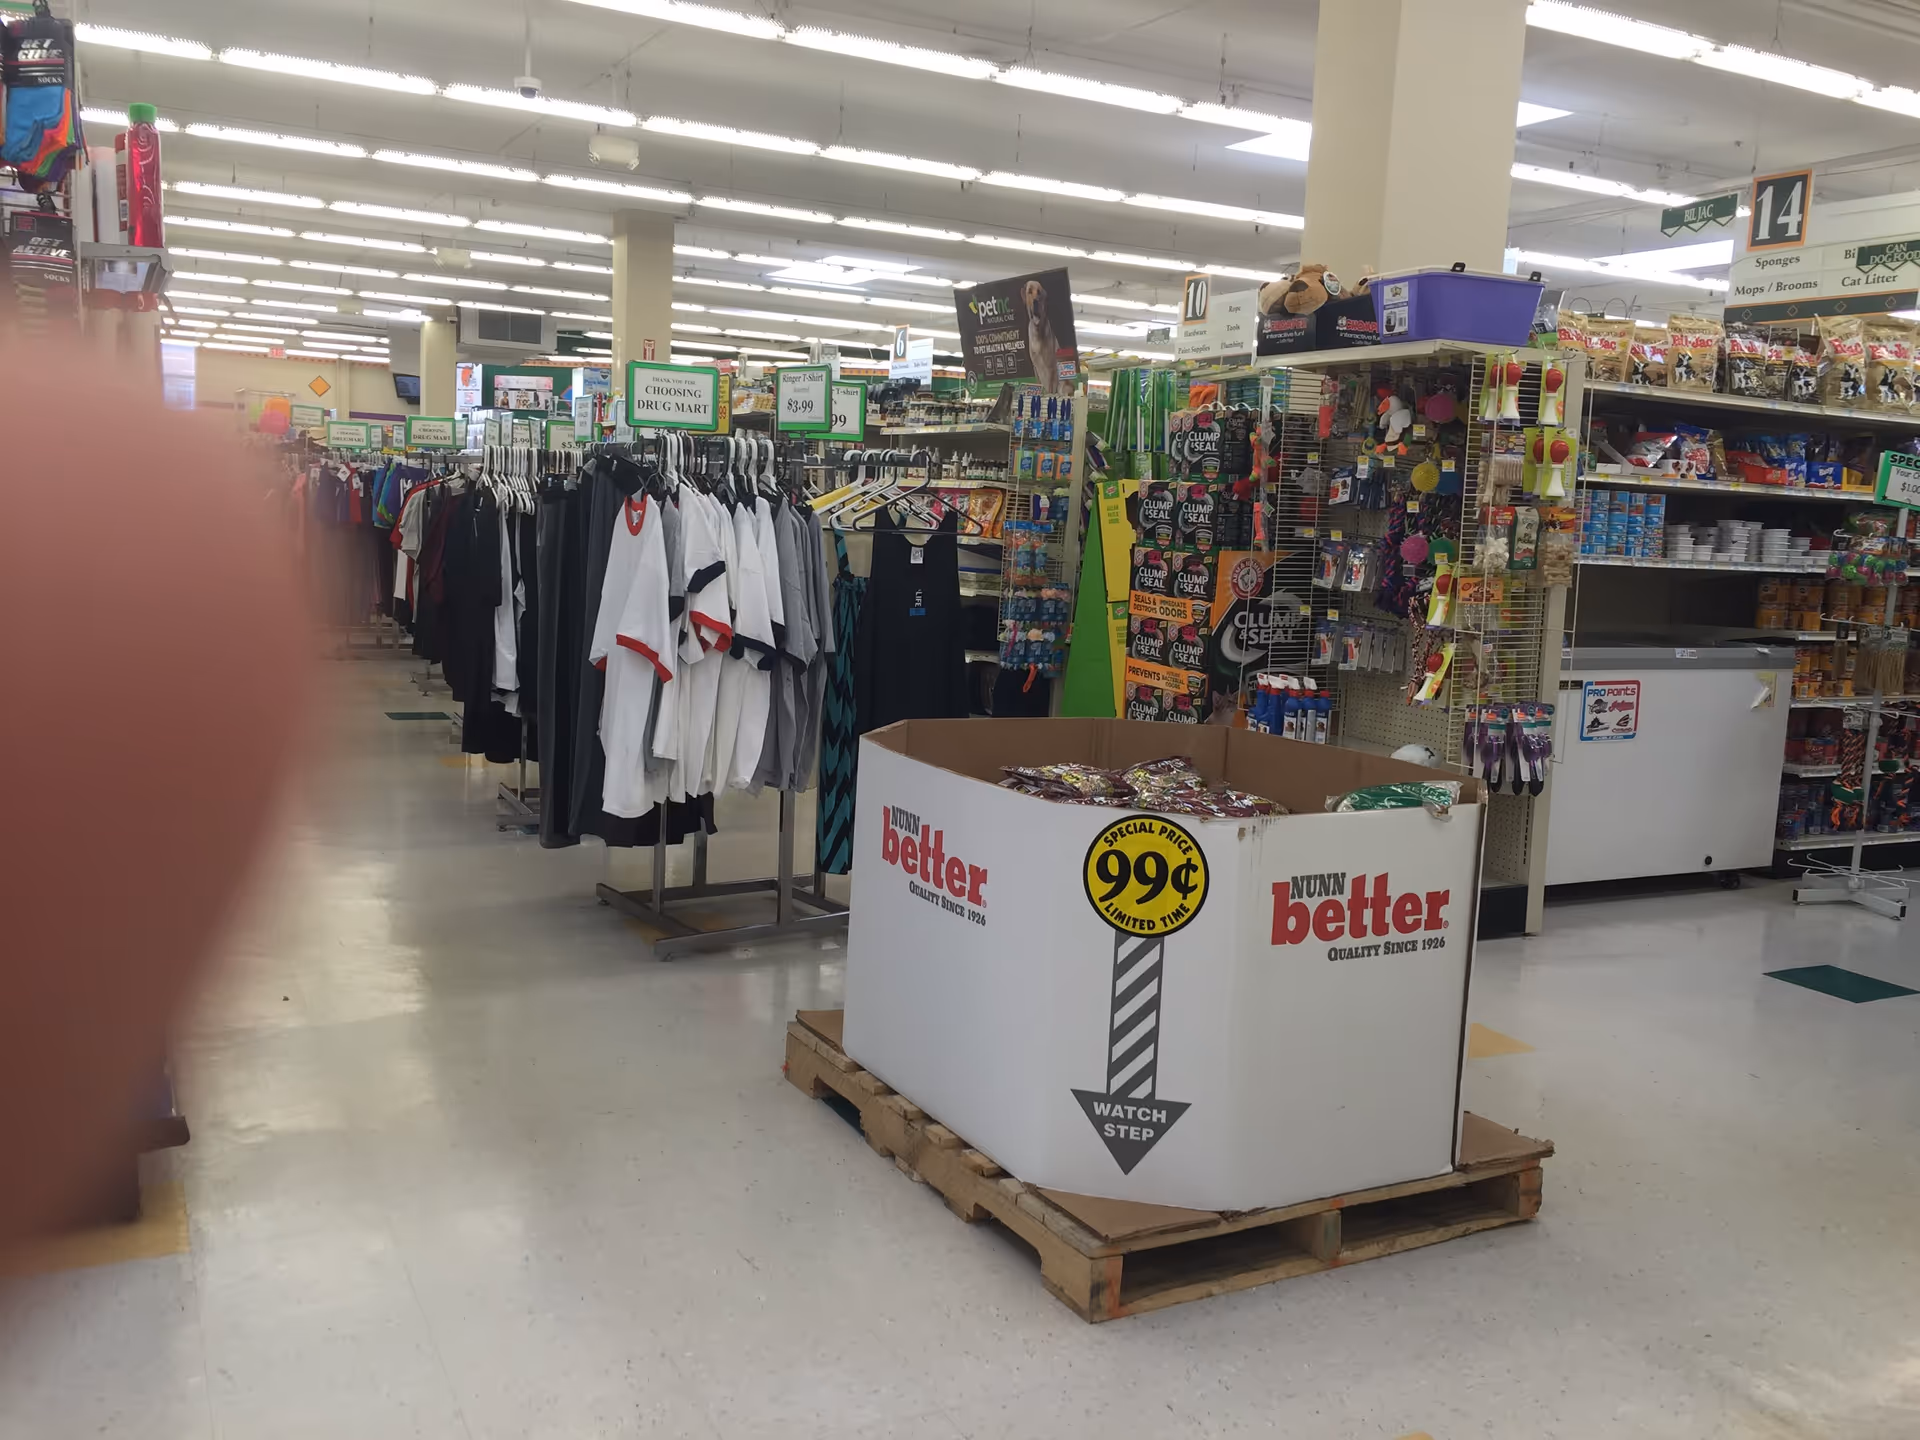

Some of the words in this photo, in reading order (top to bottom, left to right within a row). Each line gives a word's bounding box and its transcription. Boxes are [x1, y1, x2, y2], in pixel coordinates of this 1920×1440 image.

[1684, 208, 1697, 222] BIL
[1697, 204, 1714, 222] JAC
[1755, 180, 1803, 241] 14
[29, 237, 63, 247] GET
[1886, 243, 1908, 254] CAN
[13, 245, 71, 257] ACTIVE
[1755, 255, 1801, 270] Sponges
[1870, 253, 1892, 265] DOG
[44, 273, 70, 282] SOCKS
[1841, 276, 1862, 287] Cat
[1865, 272, 1899, 285] Litter
[1734, 284, 1765, 297] Mops
[1775, 279, 1818, 292] Brooms
[1186, 281, 1207, 318] 10
[896, 330, 905, 357] 6
[782, 374, 801, 384] Ringer
[803, 373, 824, 382] T-Shirt
[645, 385, 702, 399] CHOOSING
[637, 399, 672, 412] DRUG
[675, 402, 710, 415] MART
[787, 397, 814, 413] $3.99
[1188, 431, 1220, 442] CLUMP
[1889, 454, 1920, 468] SPEC
[1896, 468, 1913, 477] Your
[1143, 499, 1173, 509] CLUMP
[1182, 502, 1214, 513] CLUMP
[1139, 566, 1168, 579] CLUMP
[1177, 572, 1209, 584] CLUMP
[1134, 594, 1151, 605] SEALS
[1159, 607, 1187, 619] ODORS
[1234, 611, 1303, 629] CLUMP
[1135, 634, 1164, 649] CLUMP
[1173, 642, 1203, 655] CLUMP
[1128, 665, 1161, 681] PREVENTS
[1587, 688, 1606, 696] PRO
[1130, 701, 1159, 716] CLUMP
[1168, 710, 1198, 724] CLUMP
[891, 805, 920, 836] NUNN
[1103, 821, 1155, 847] SPECIAL
[1158, 825, 1193, 856] PRICE
[882, 805, 988, 907] better
[1096, 849, 1199, 905] 99¢
[1291, 872, 1346, 899] NUNN
[909, 880, 940, 906] QUALITY
[941, 895, 965, 917] SINCE
[967, 909, 986, 927] 1926
[1271, 872, 1450, 946] better
[1104, 902, 1156, 931] LIMITED
[1160, 902, 1190, 928] TIME
[1328, 944, 1381, 961] QUALITY
[1384, 940, 1418, 956] SINCE
[1422, 936, 1446, 950] 1926
[1093, 1101, 1167, 1124] WATCH
[1104, 1123, 1155, 1141] STEP
